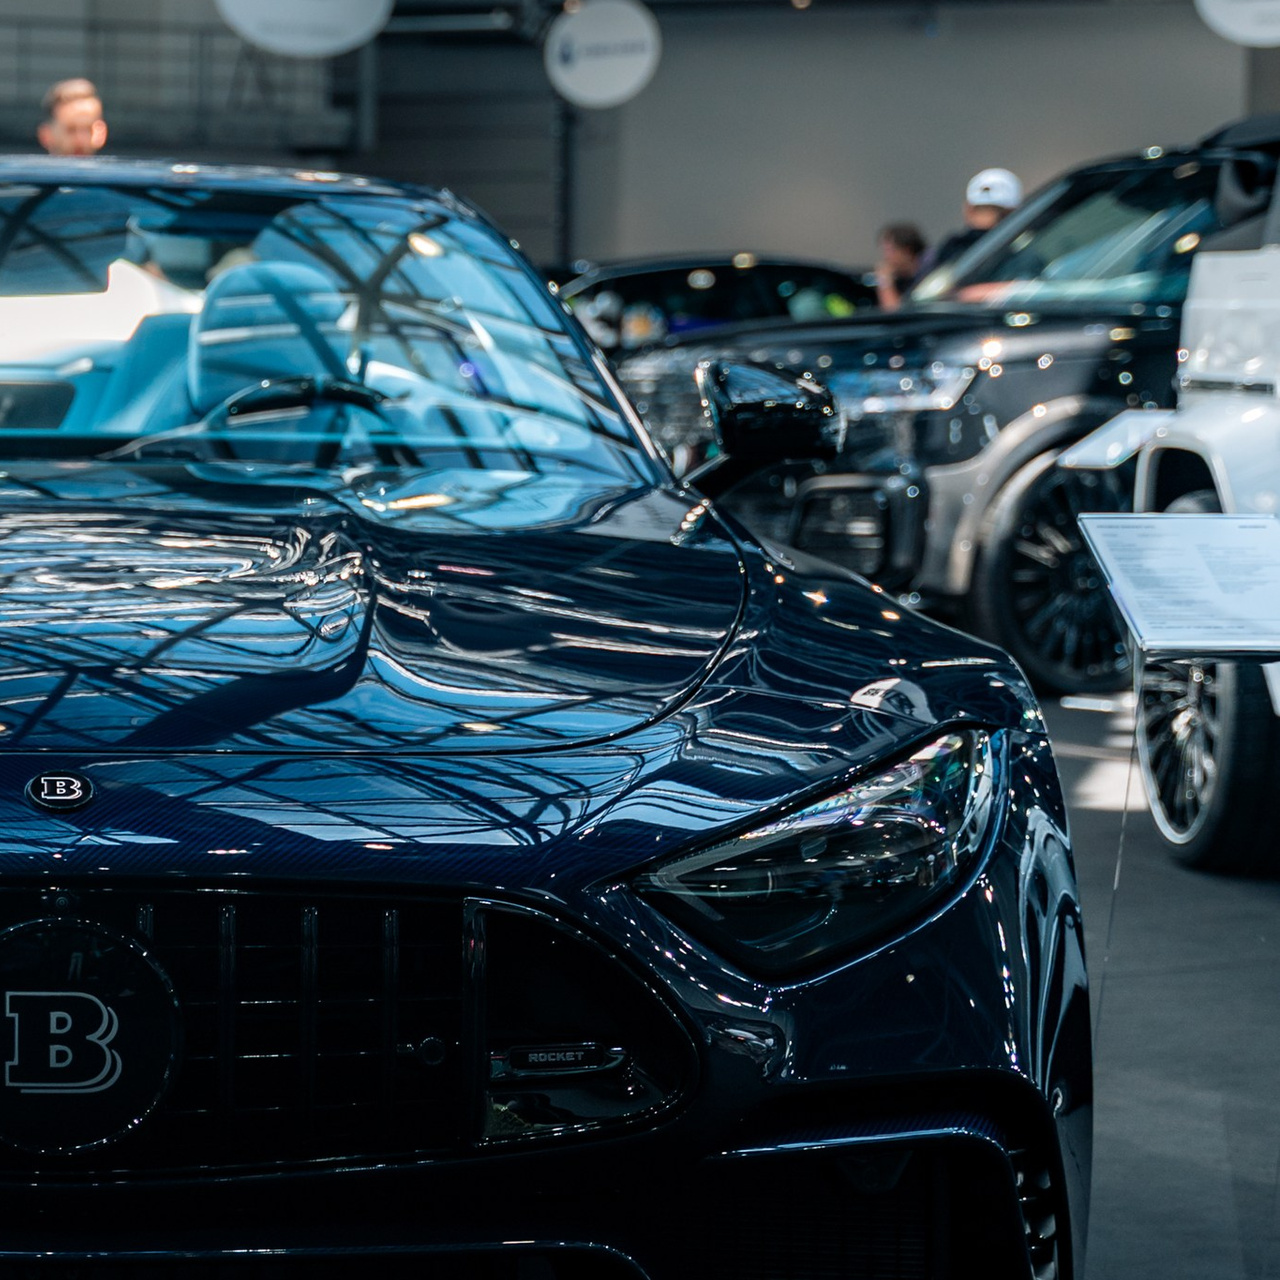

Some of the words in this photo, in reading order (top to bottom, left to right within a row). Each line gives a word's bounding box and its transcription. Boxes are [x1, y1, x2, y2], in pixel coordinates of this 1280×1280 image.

[41, 776, 83, 799] B
[5, 991, 122, 1093] B
[528, 1051, 584, 1062] ROCKET
